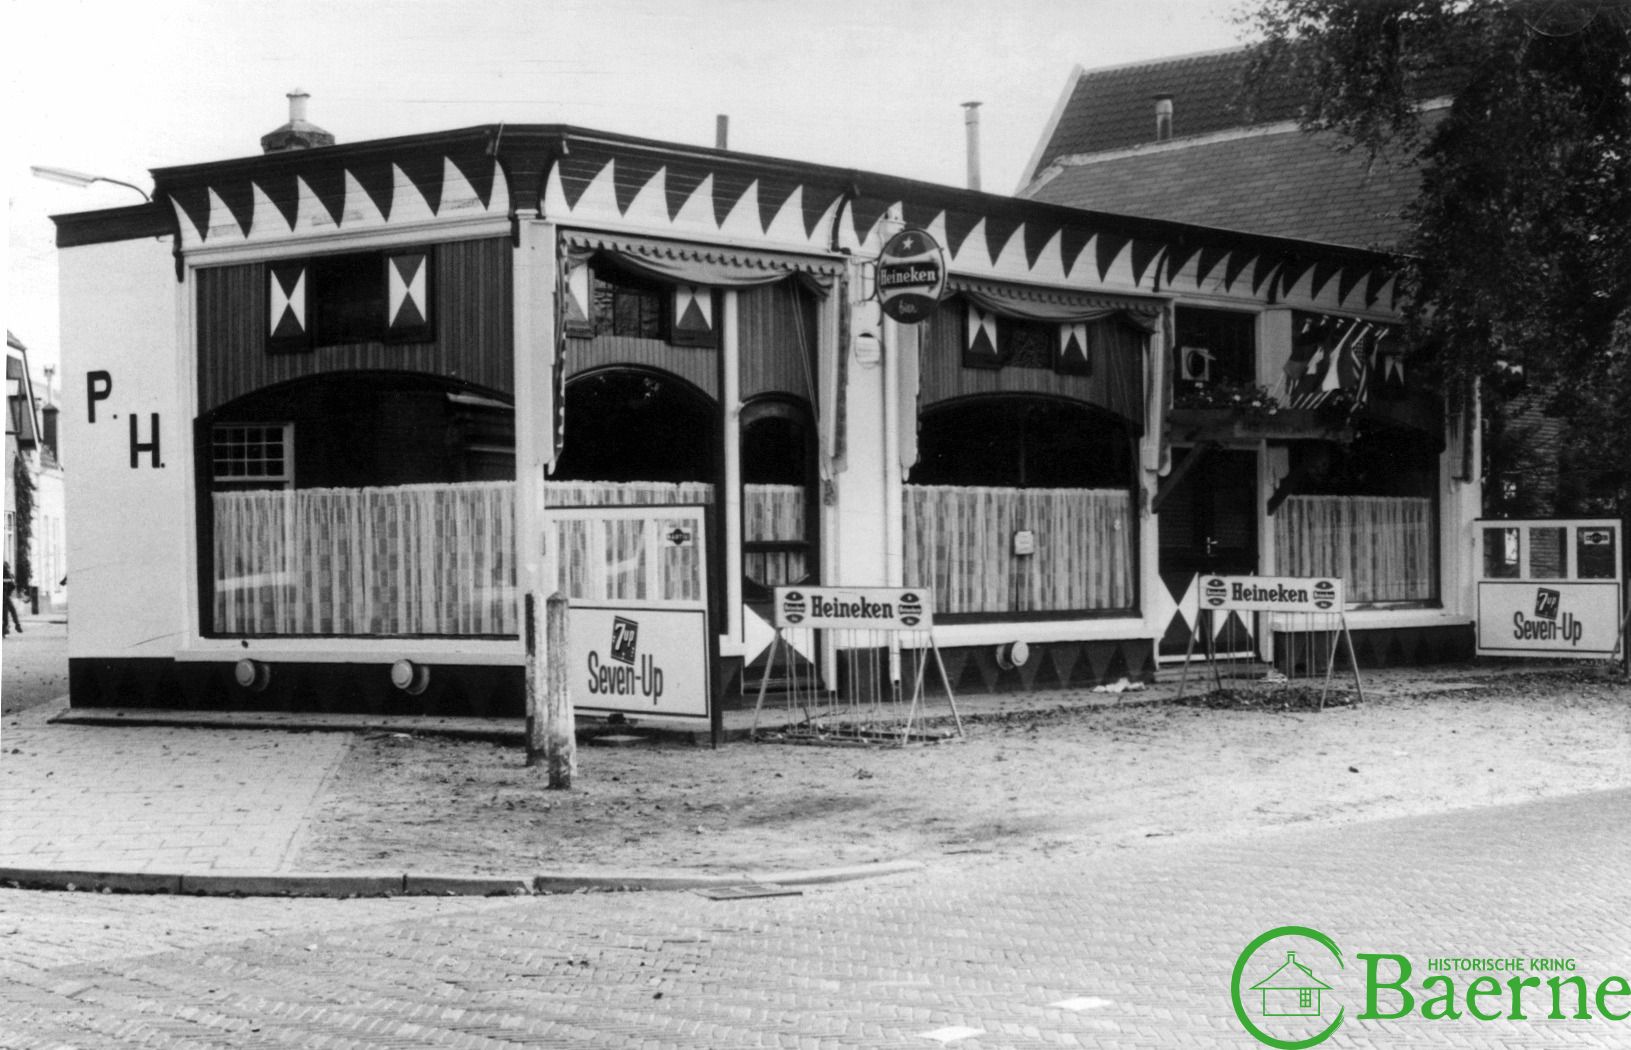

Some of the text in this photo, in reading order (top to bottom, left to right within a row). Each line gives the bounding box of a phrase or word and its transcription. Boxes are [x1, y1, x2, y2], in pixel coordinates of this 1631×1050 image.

[880, 266, 936, 286] Heineken
[1231, 582, 1309, 603] Heineken
[811, 595, 894, 619] Heineken
[1513, 611, 1582, 646] Seven-Up
[588, 650, 664, 705] Seven-Up
